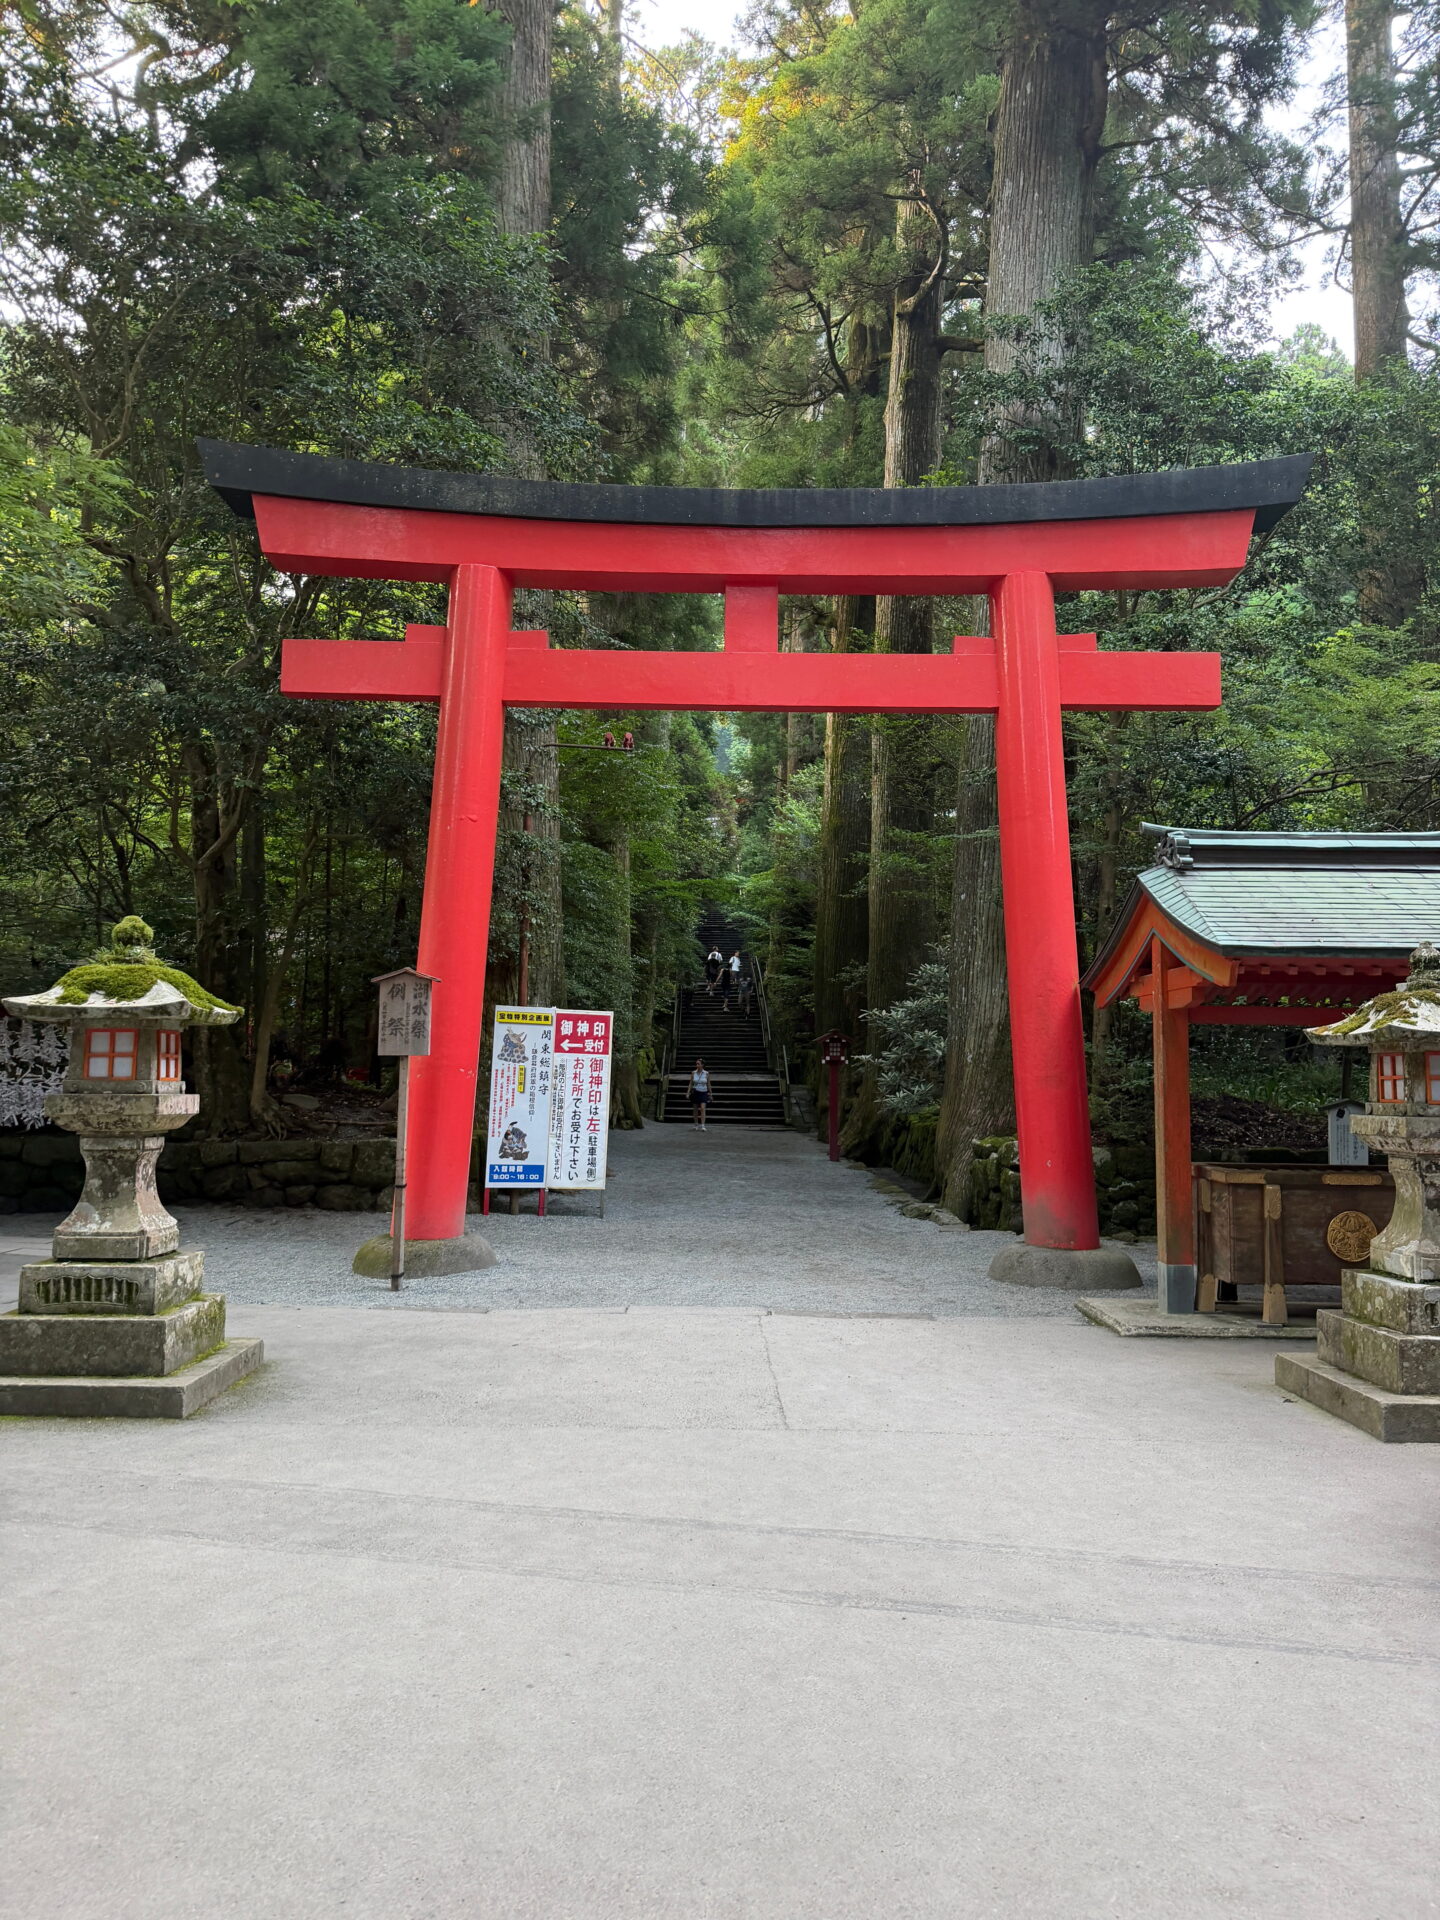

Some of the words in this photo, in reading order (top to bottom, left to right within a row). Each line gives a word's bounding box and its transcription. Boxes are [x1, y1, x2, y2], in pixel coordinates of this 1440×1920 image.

[411, 982, 429, 1039] 湖水祭
[560, 1019, 605, 1037] 御神印
[584, 1039, 604, 1053] 受付
[568, 1057, 584, 1181] お札所でお受け下さい
